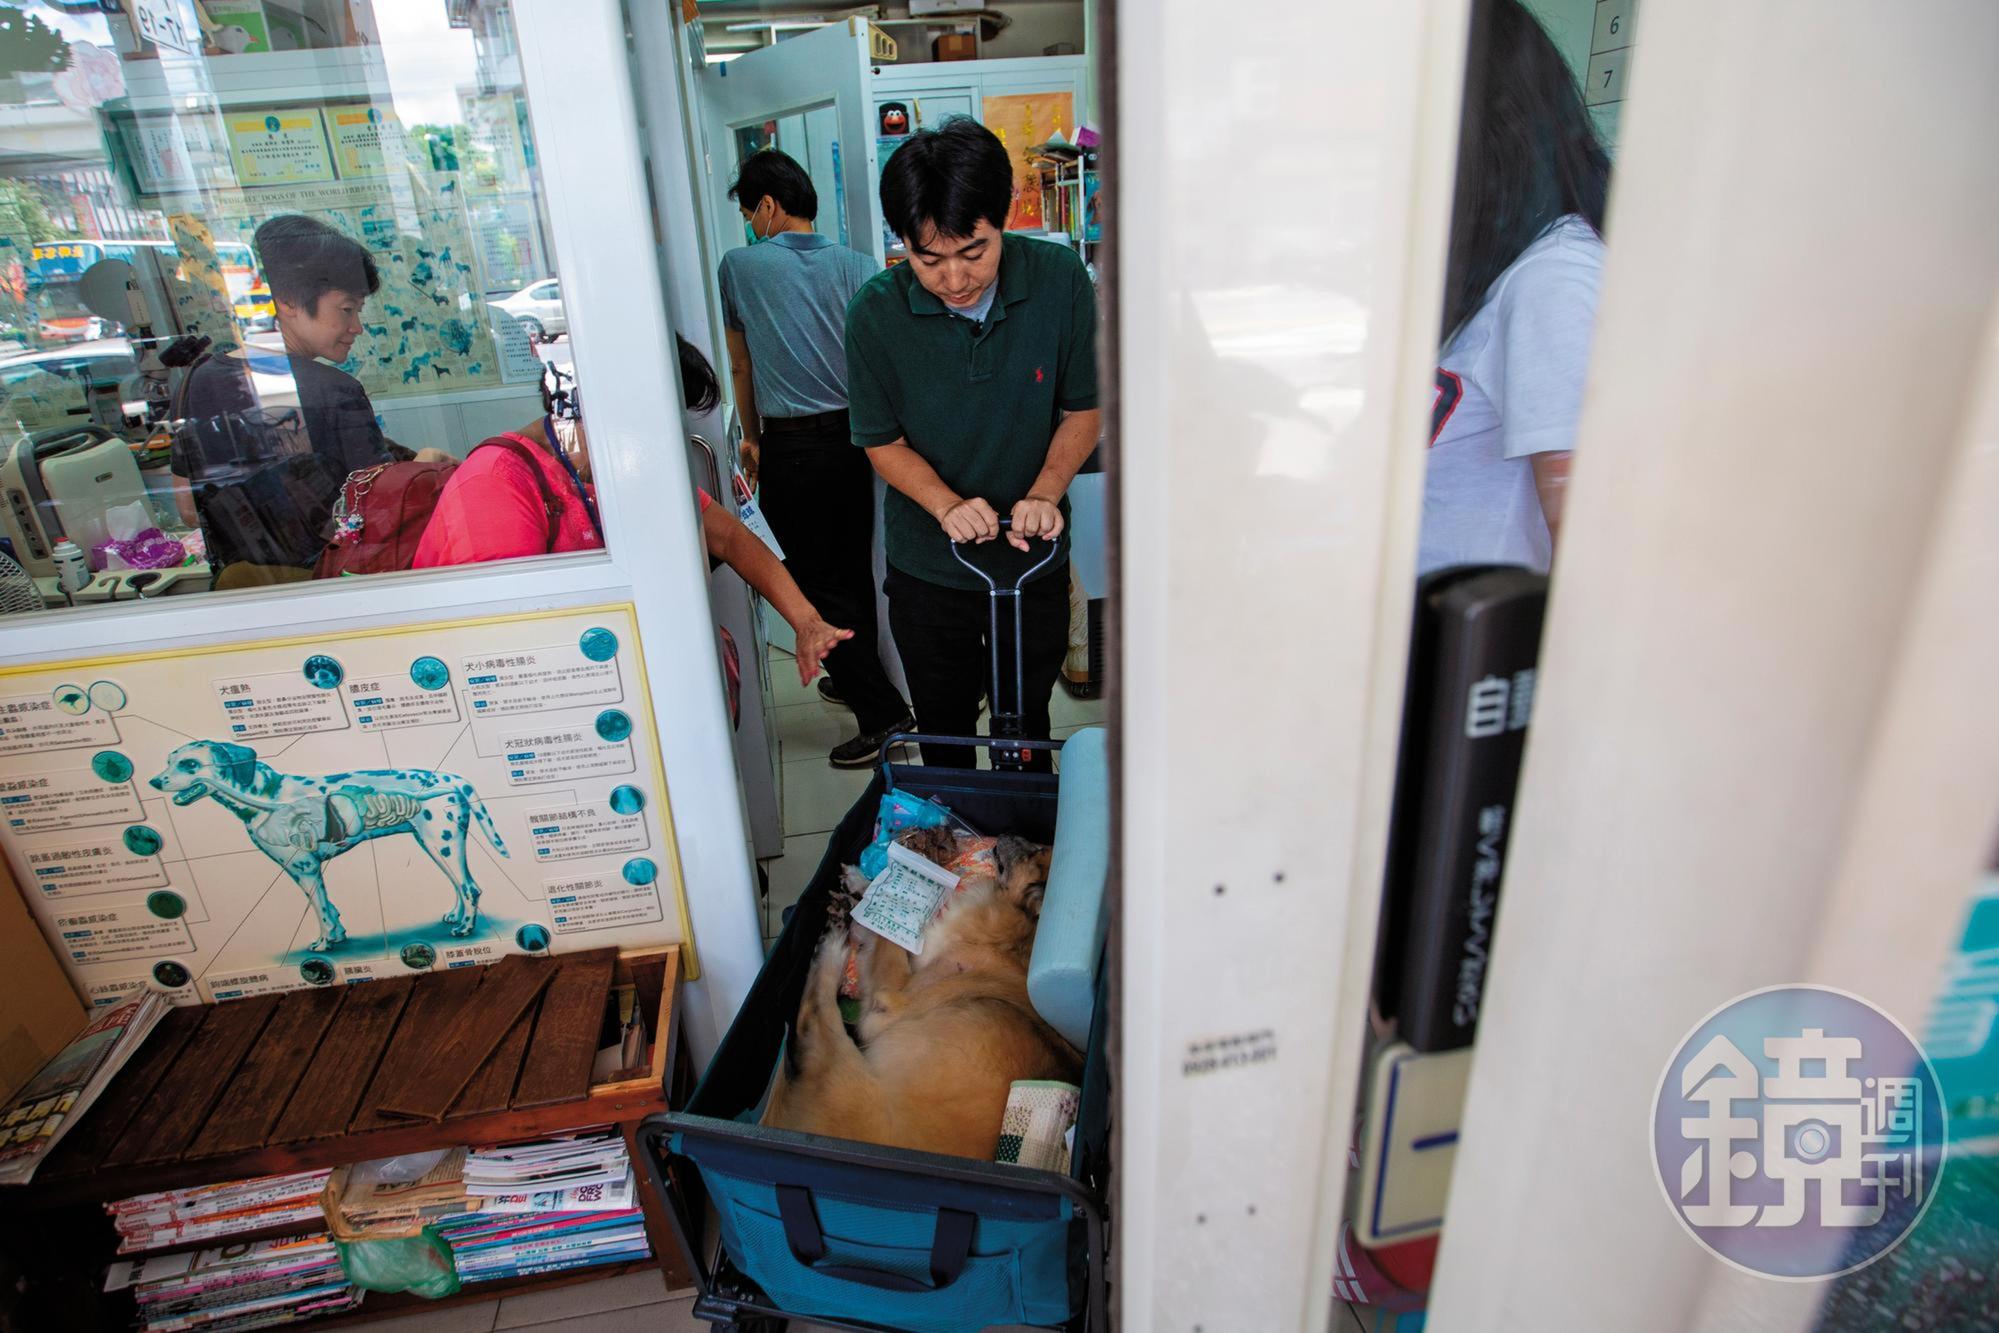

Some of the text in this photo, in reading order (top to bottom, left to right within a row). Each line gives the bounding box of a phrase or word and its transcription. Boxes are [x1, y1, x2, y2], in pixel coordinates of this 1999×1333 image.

[1609, 15, 1620, 35] 6
[1603, 69, 1613, 89] 7
[465, 655, 537, 672] 犬小病毒性腸炎
[219, 683, 252, 696] 犬瘟熱
[504, 732, 584, 749] 犬冠狀病毒性腸炎
